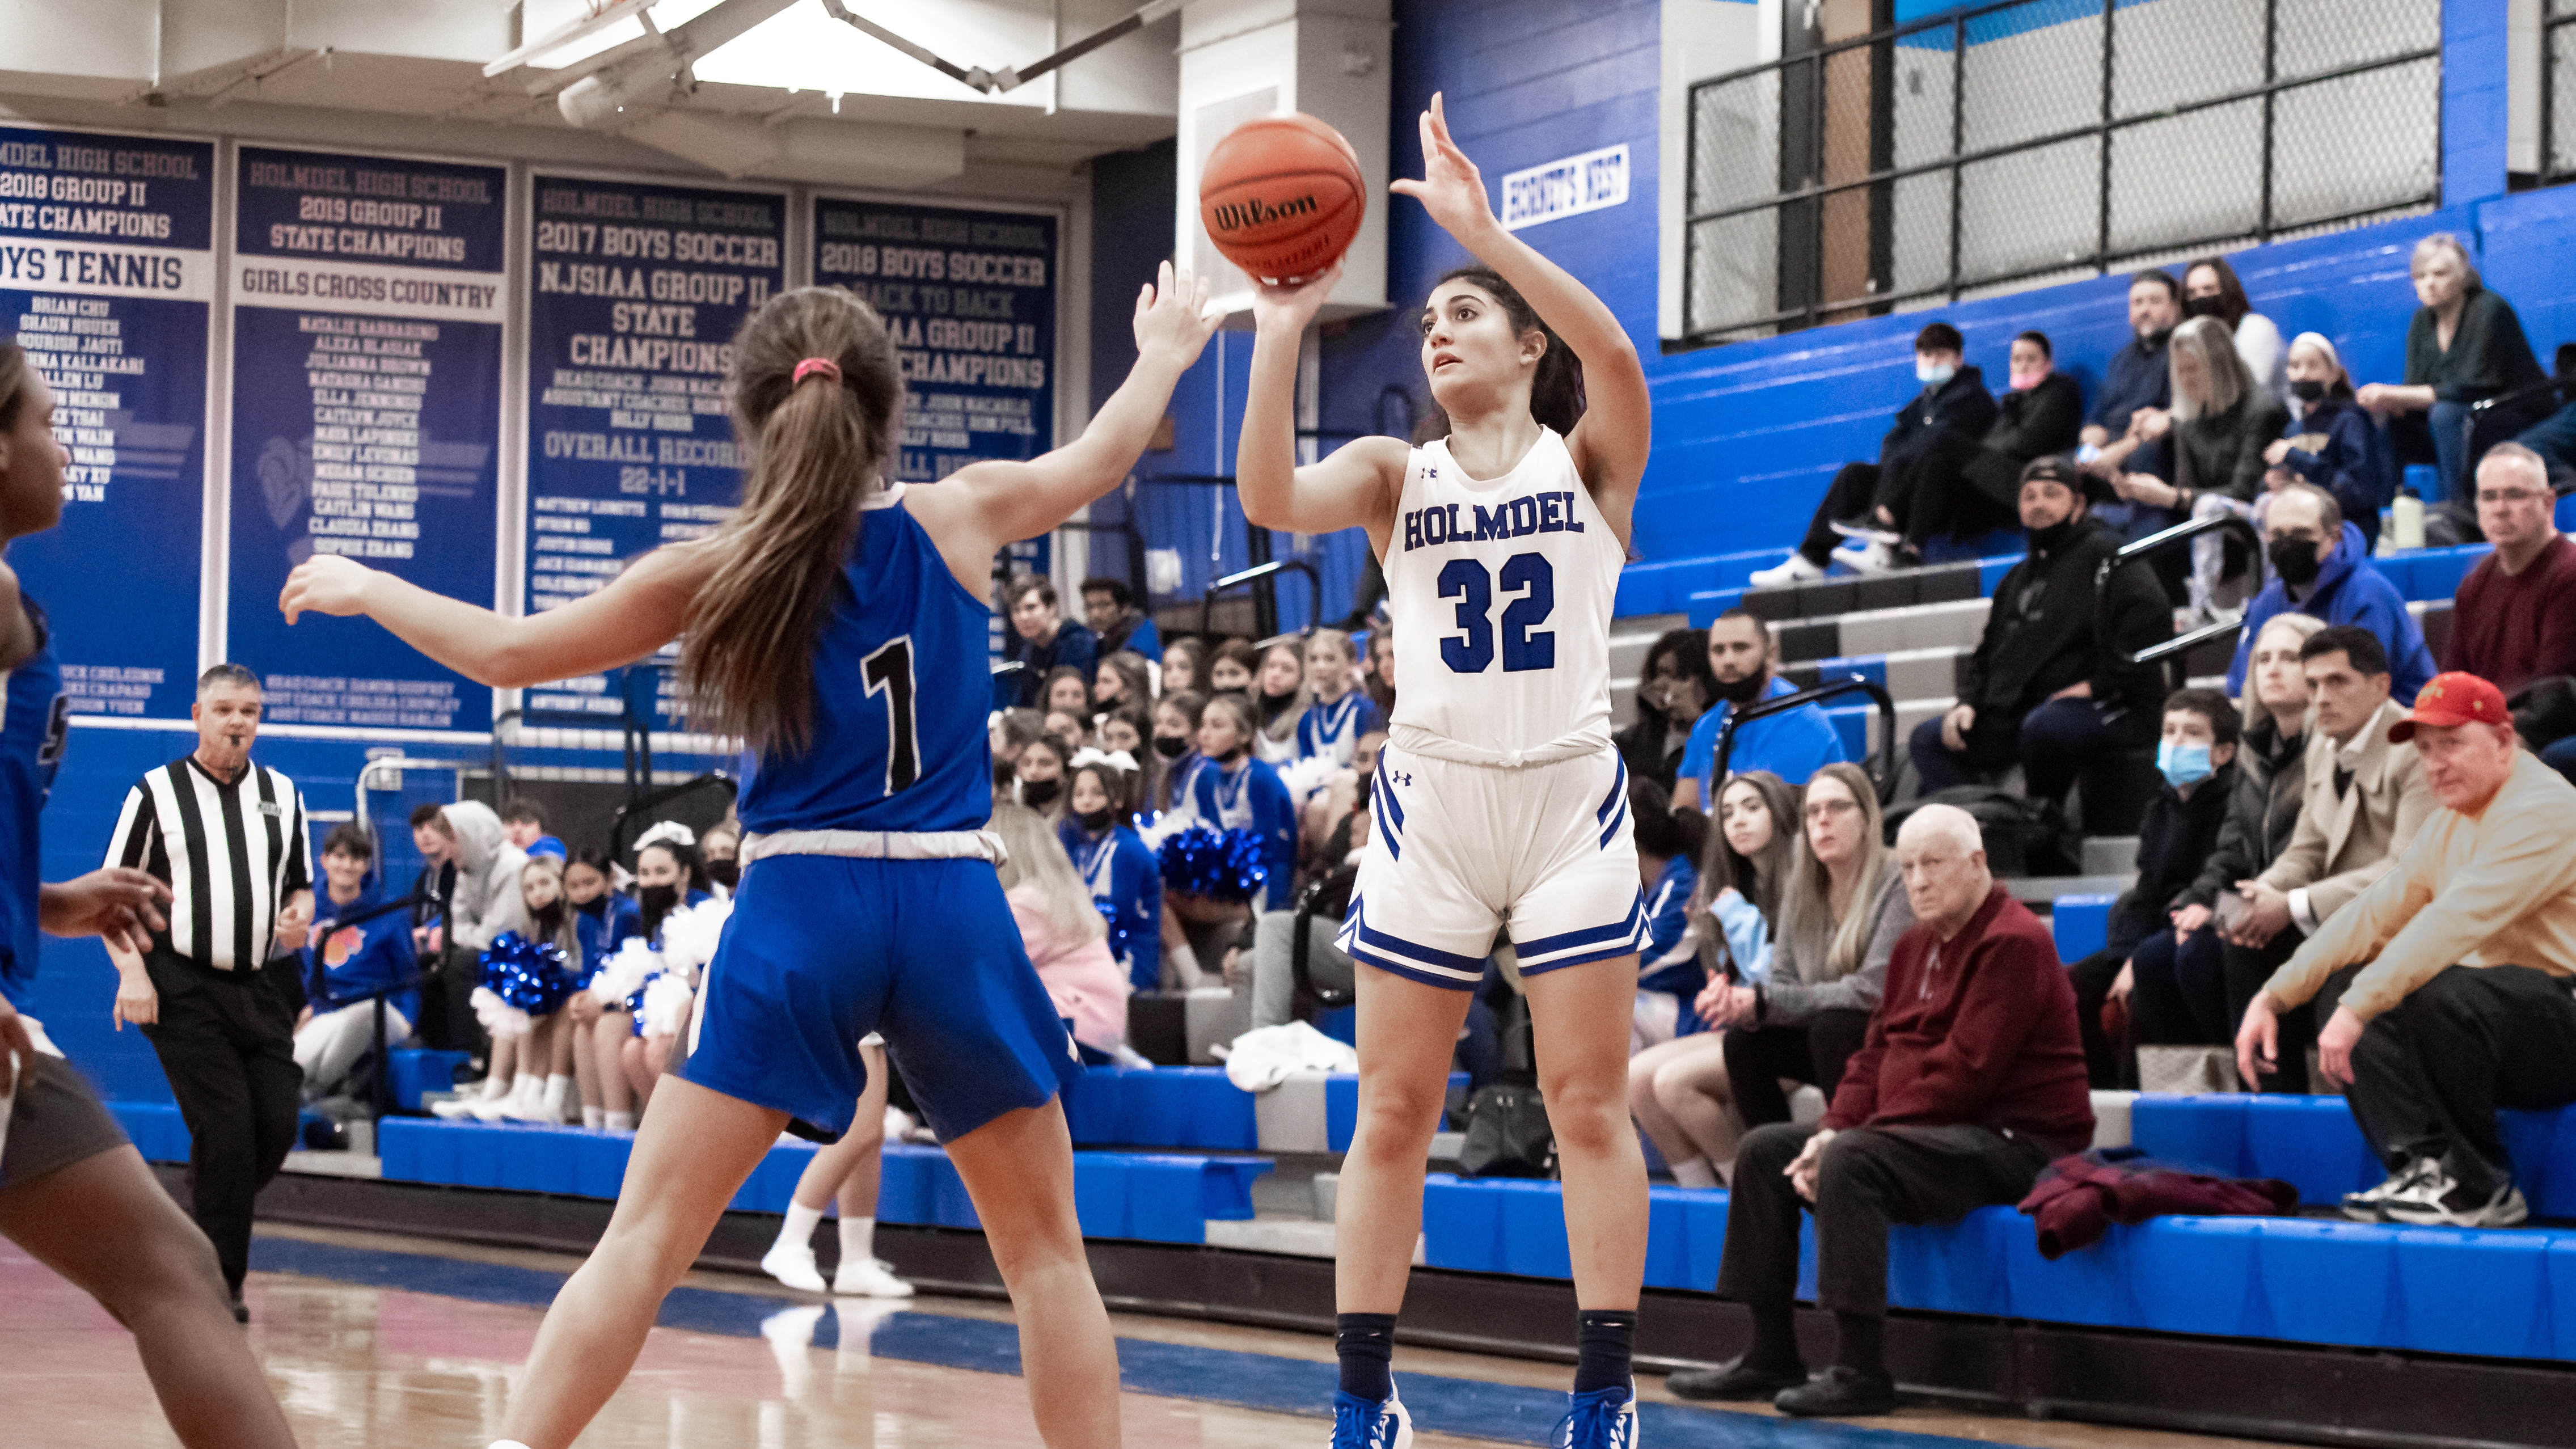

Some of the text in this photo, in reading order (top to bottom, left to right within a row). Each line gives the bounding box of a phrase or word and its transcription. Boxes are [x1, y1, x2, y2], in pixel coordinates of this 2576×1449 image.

[57, 146, 109, 172] HIGH
[115, 151, 198, 179] SCHOOL
[1585, 154, 1621, 204] NEST
[0, 172, 147, 206] 2018 GROUP II
[250, 162, 492, 204] HOLMDEL HIGH SCHOOL
[39, 206, 171, 238] CHAMPIONS
[300, 196, 442, 230] 2019 GROUP II
[542, 188, 639, 219] HOLMDEL
[1214, 196, 1317, 231] Wilson
[271, 223, 465, 262] STATE CHAMPIONS
[538, 221, 778, 268] 2017 BOYS SOCCER
[0, 246, 183, 290] YS TENNIS
[540, 261, 645, 299] NJSIAA
[651, 269, 744, 305] GROUP
[821, 242, 1045, 287] 2018 BOYS SOCCER
[242, 267, 497, 309] GIRLS CROSS COUNTRY
[920, 286, 949, 314] TO
[953, 289, 1015, 318] BACK
[613, 302, 696, 337] STATE
[927, 319, 1013, 353] GROUP
[1017, 323, 1035, 354] II
[570, 334, 737, 375] CHAMPIONS
[901, 350, 1045, 389] CHAMPIONS
[544, 430, 653, 463] OVERALL
[620, 466, 685, 495] 22-1-1
[1405, 492, 1584, 552] HOLMDEL
[1437, 552, 1555, 673] 32
[860, 633, 922, 797] 1
